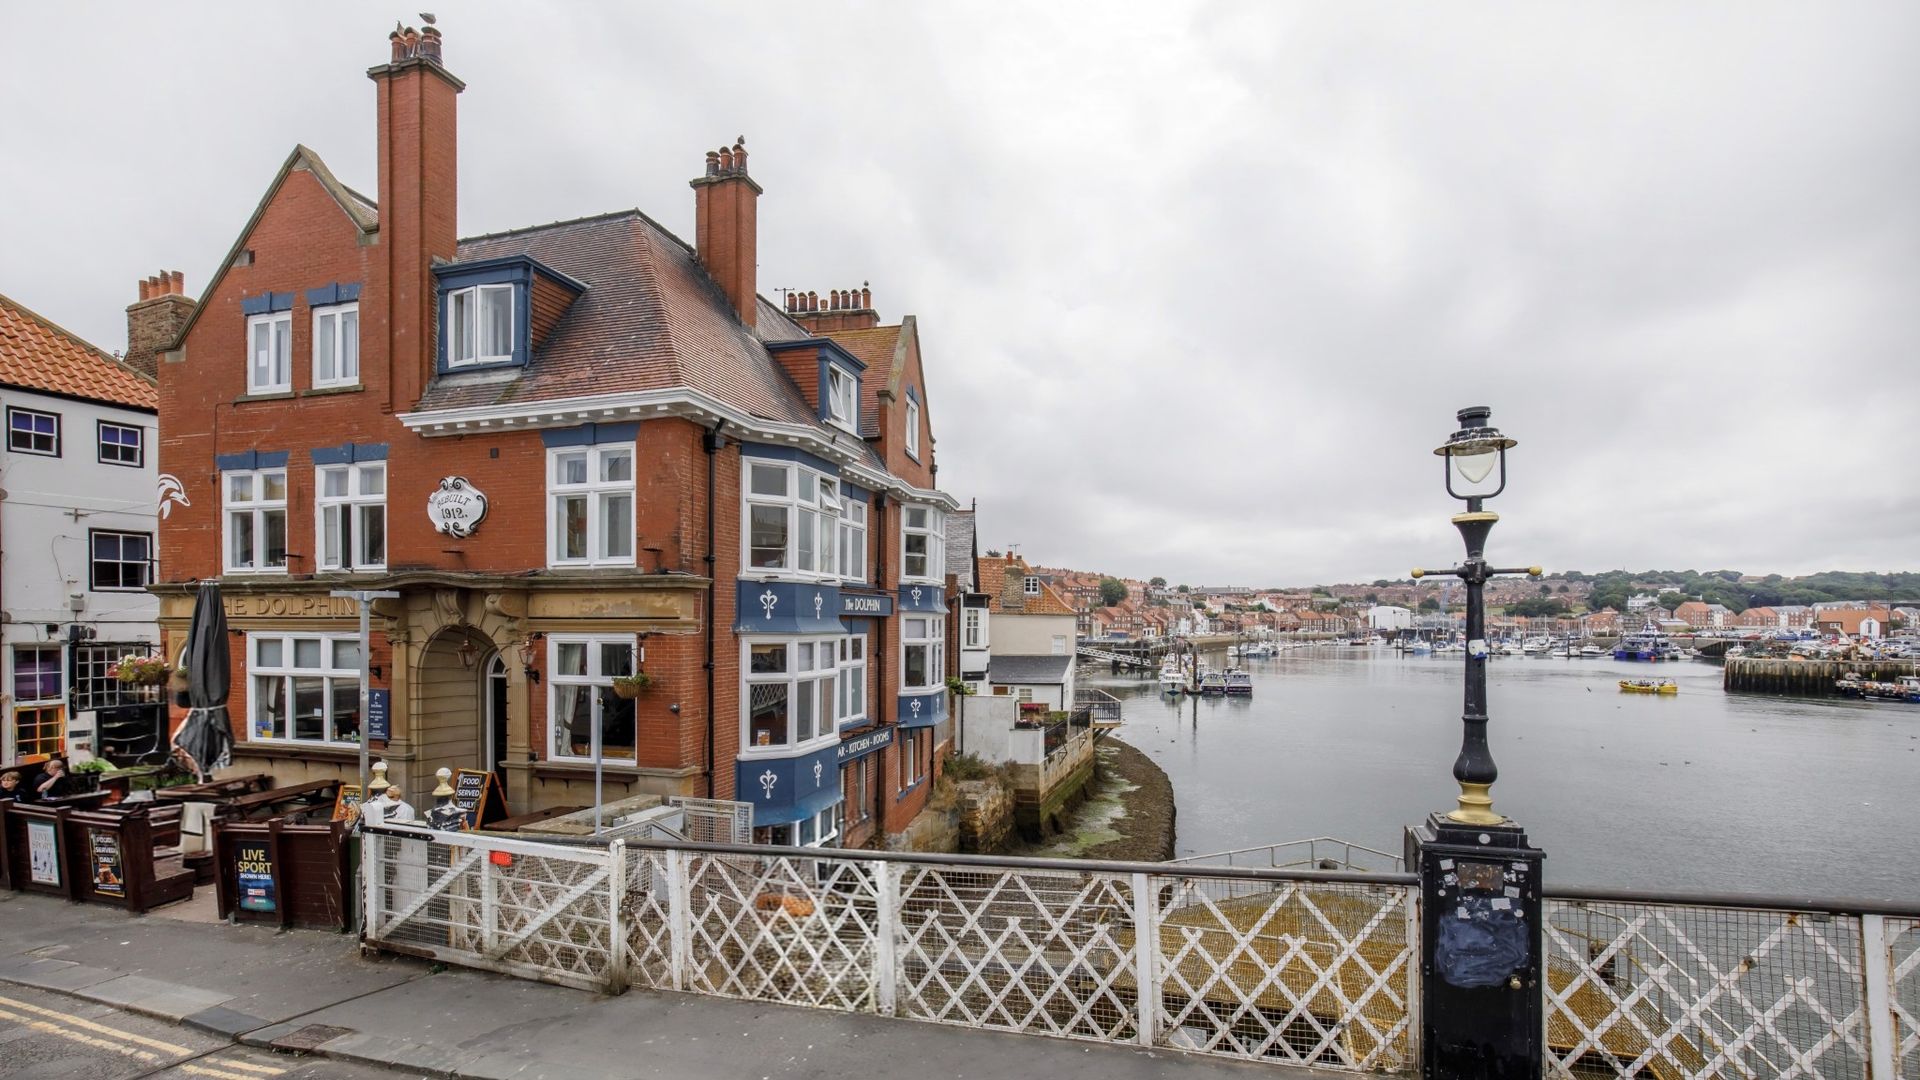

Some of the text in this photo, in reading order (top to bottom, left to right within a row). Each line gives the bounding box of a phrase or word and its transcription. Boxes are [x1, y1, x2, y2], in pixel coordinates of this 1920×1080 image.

[224, 598, 355, 616] HE DOLPHIN
[855, 598, 880, 612] DOLPHIN
[849, 737, 870, 754] KITCHEN
[873, 731, 889, 745] ROOMS
[463, 777, 480, 785] FOOD
[458, 789, 480, 797] SERVED
[459, 801, 475, 809] DAILY
[95, 846, 116, 854] SERVED
[242, 849, 266, 861] LIVE
[238, 861, 272, 874] SPORT
